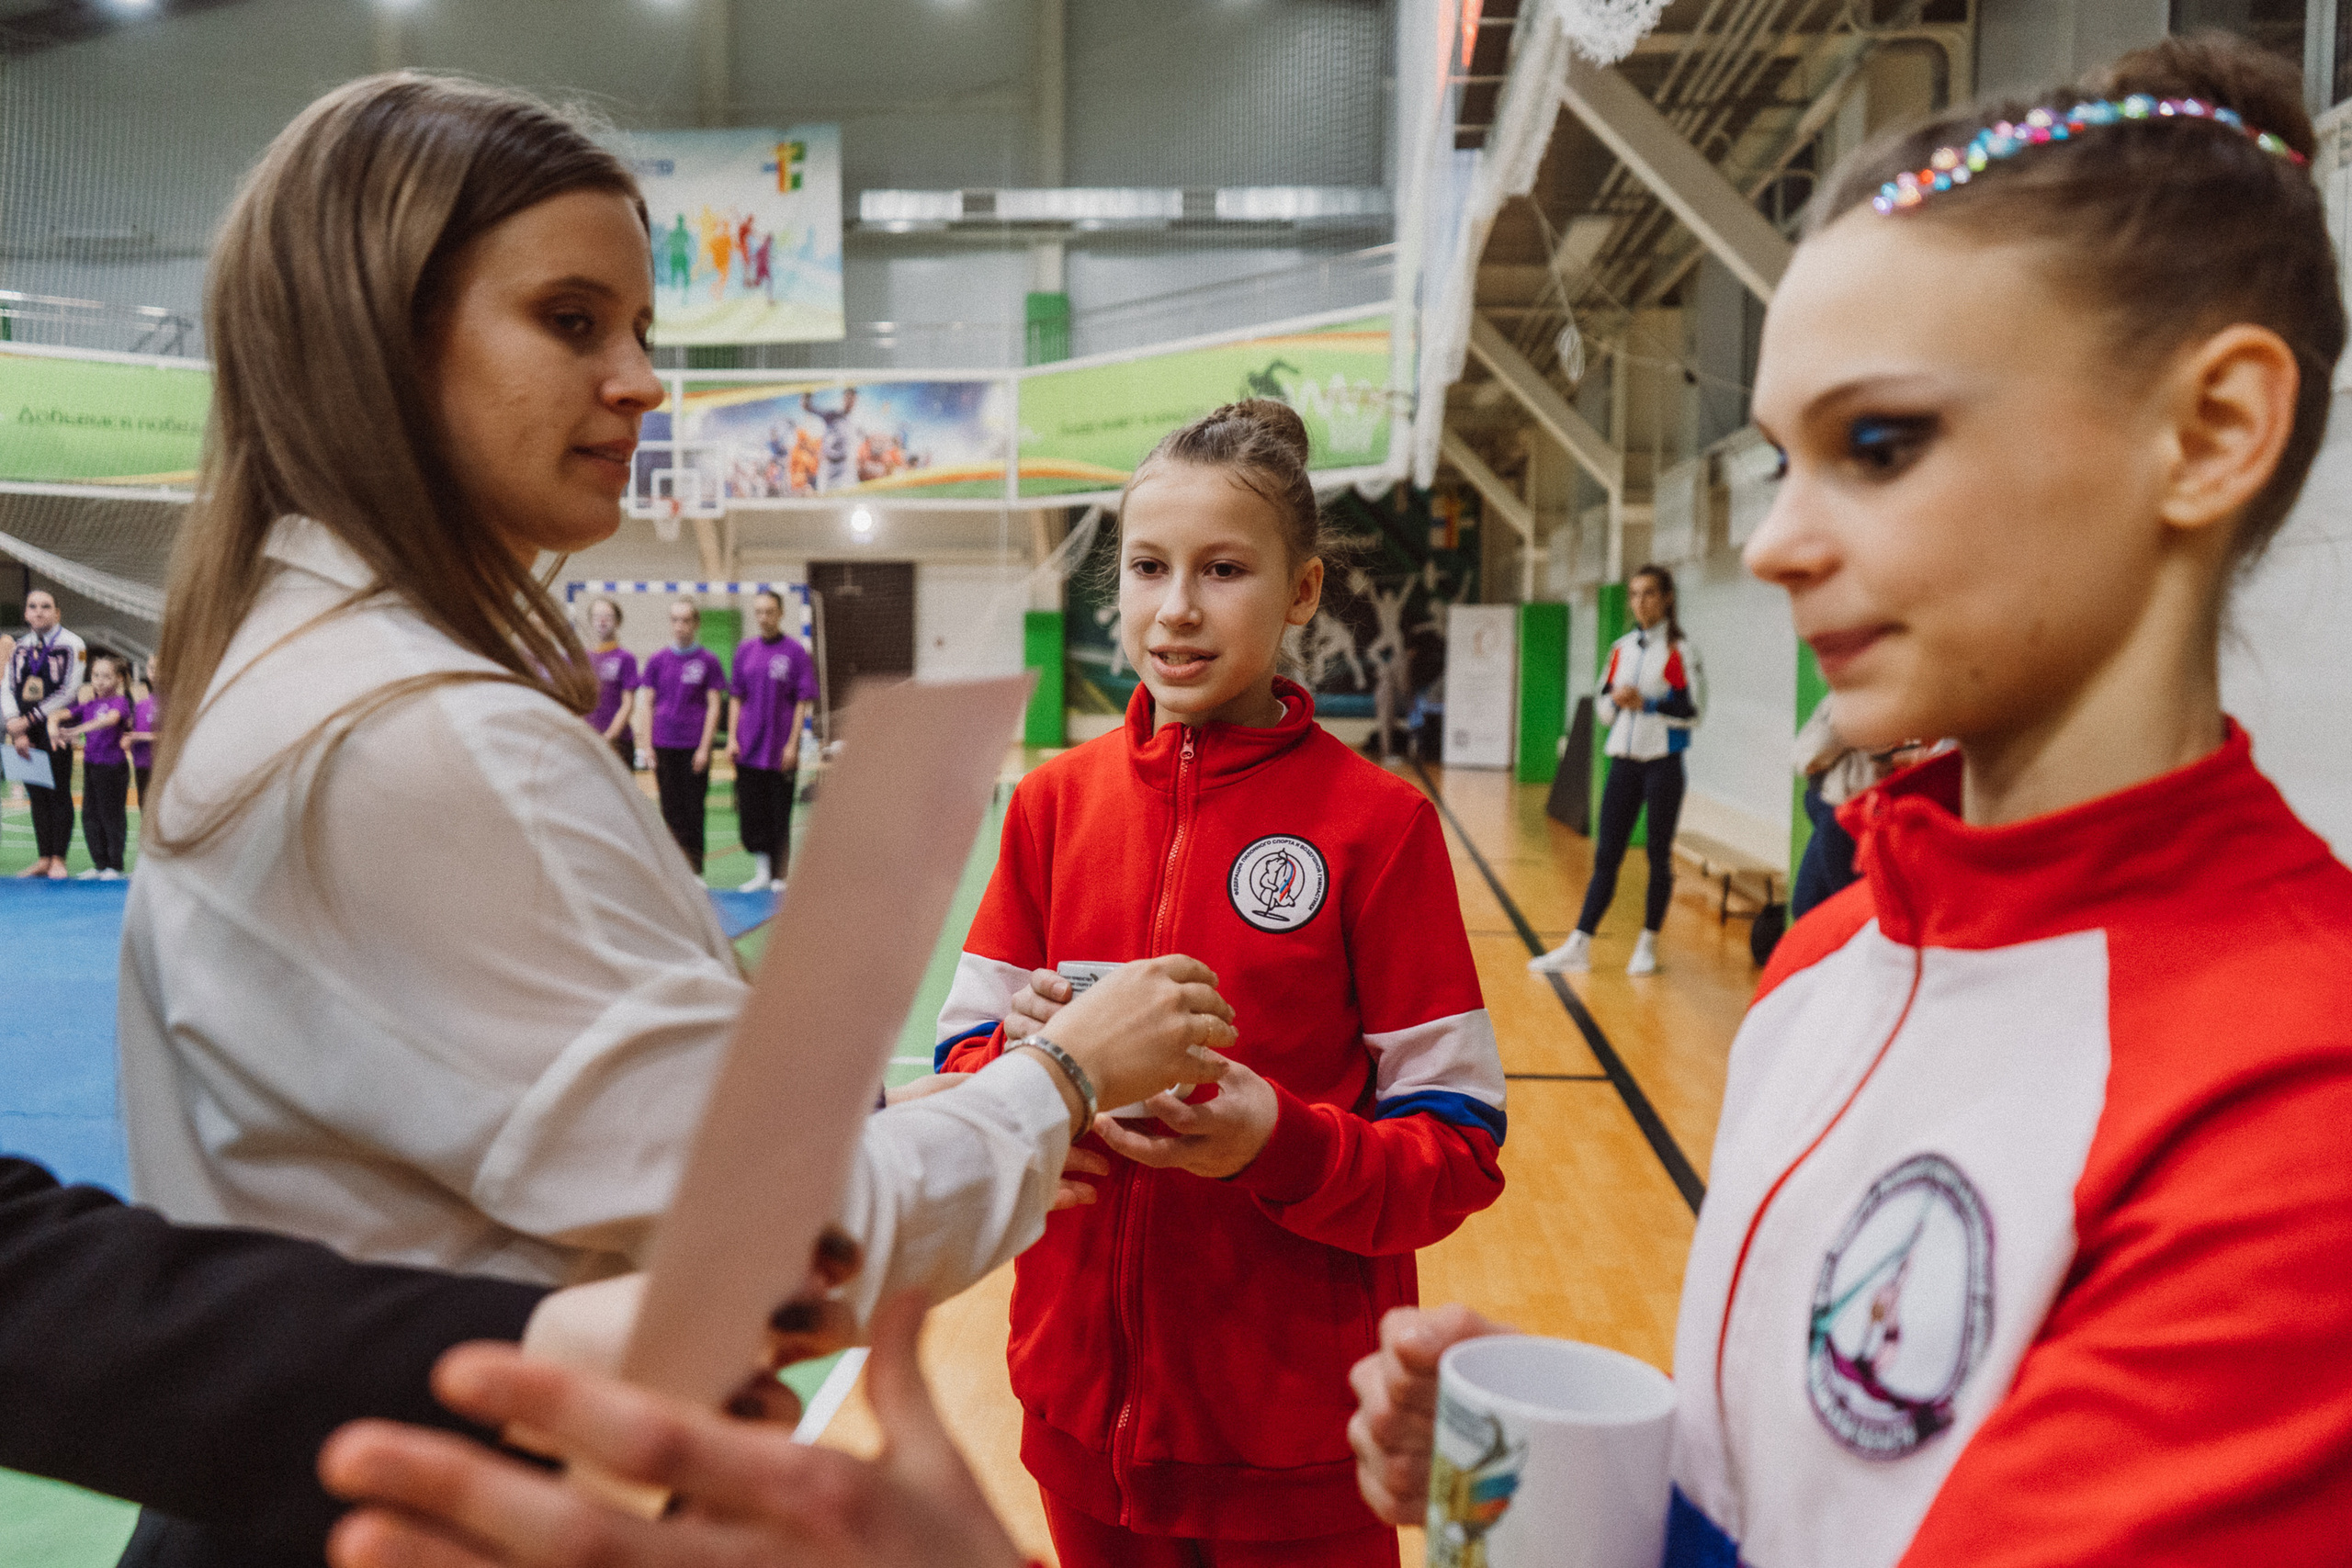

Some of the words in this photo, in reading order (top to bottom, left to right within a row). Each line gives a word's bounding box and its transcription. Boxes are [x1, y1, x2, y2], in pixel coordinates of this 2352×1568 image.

[1241, 840, 1272, 863] ПИЛОННОГО
[1299, 844, 1323, 874] ВОЗДУШНОЙ
[1233, 862, 1244, 896] ФЕДЕРАЦИЯ
[1307, 874, 1323, 911] ГИМНАСТИКИ
